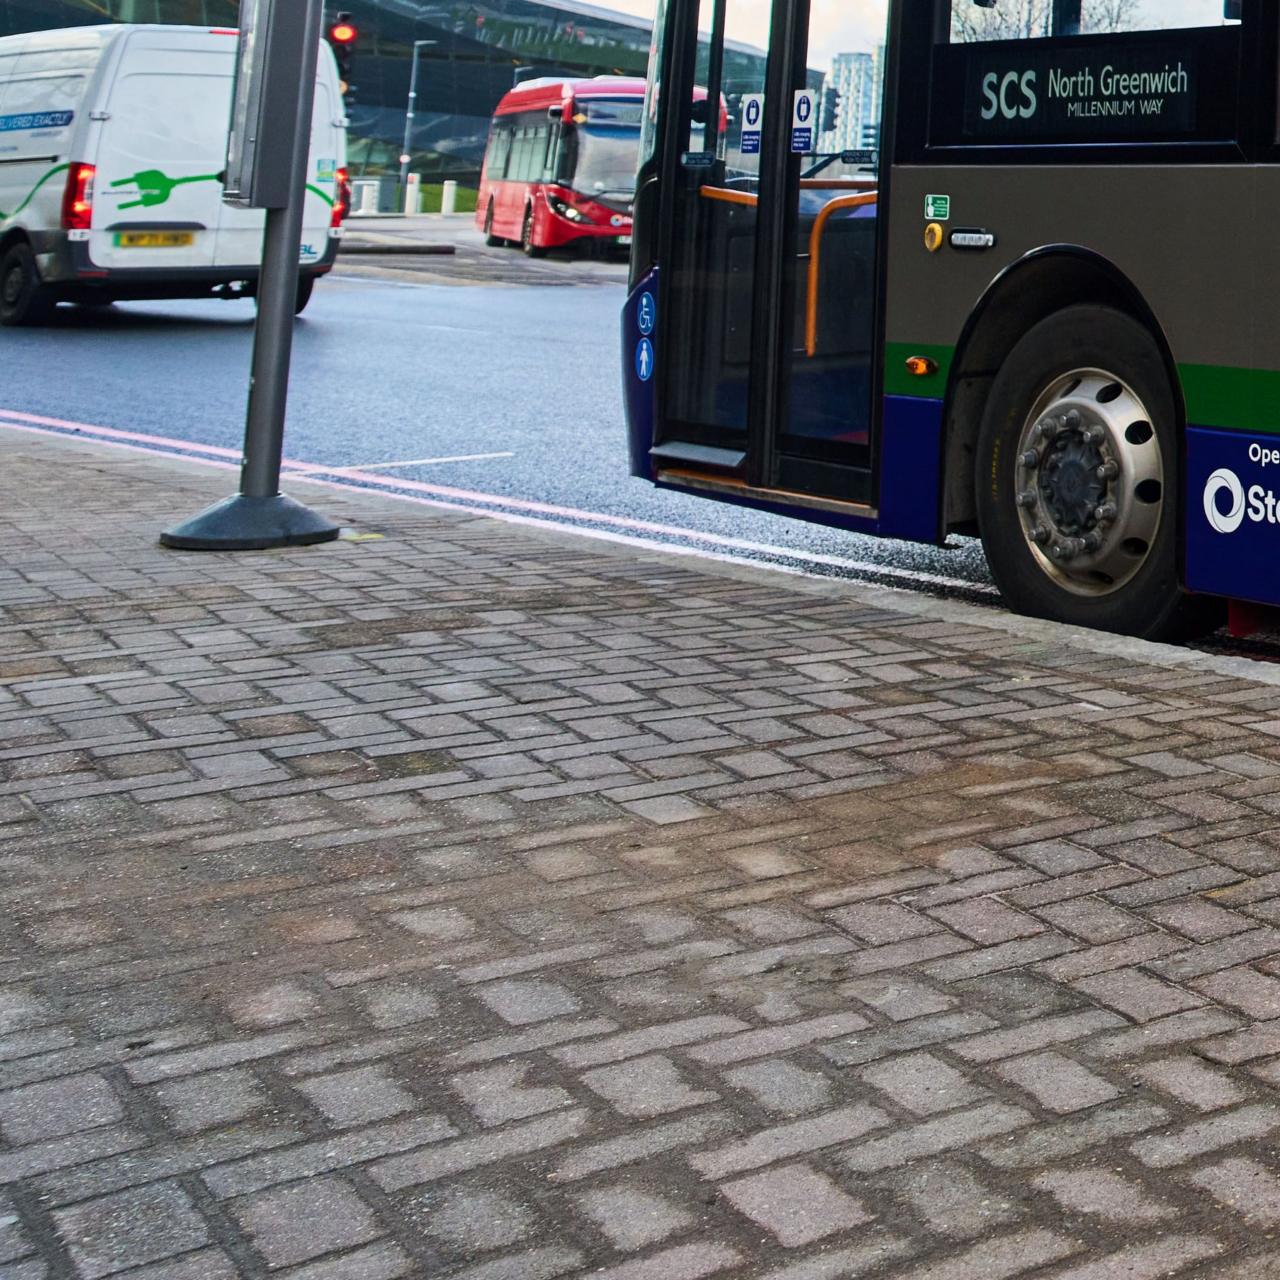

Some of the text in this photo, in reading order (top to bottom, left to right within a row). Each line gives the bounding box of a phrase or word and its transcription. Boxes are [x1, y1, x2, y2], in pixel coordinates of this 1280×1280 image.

[980, 69, 1037, 120] SCS
[1048, 61, 1188, 98] North Greenwich
[1067, 98, 1165, 118] MILLENNIUM WAY
